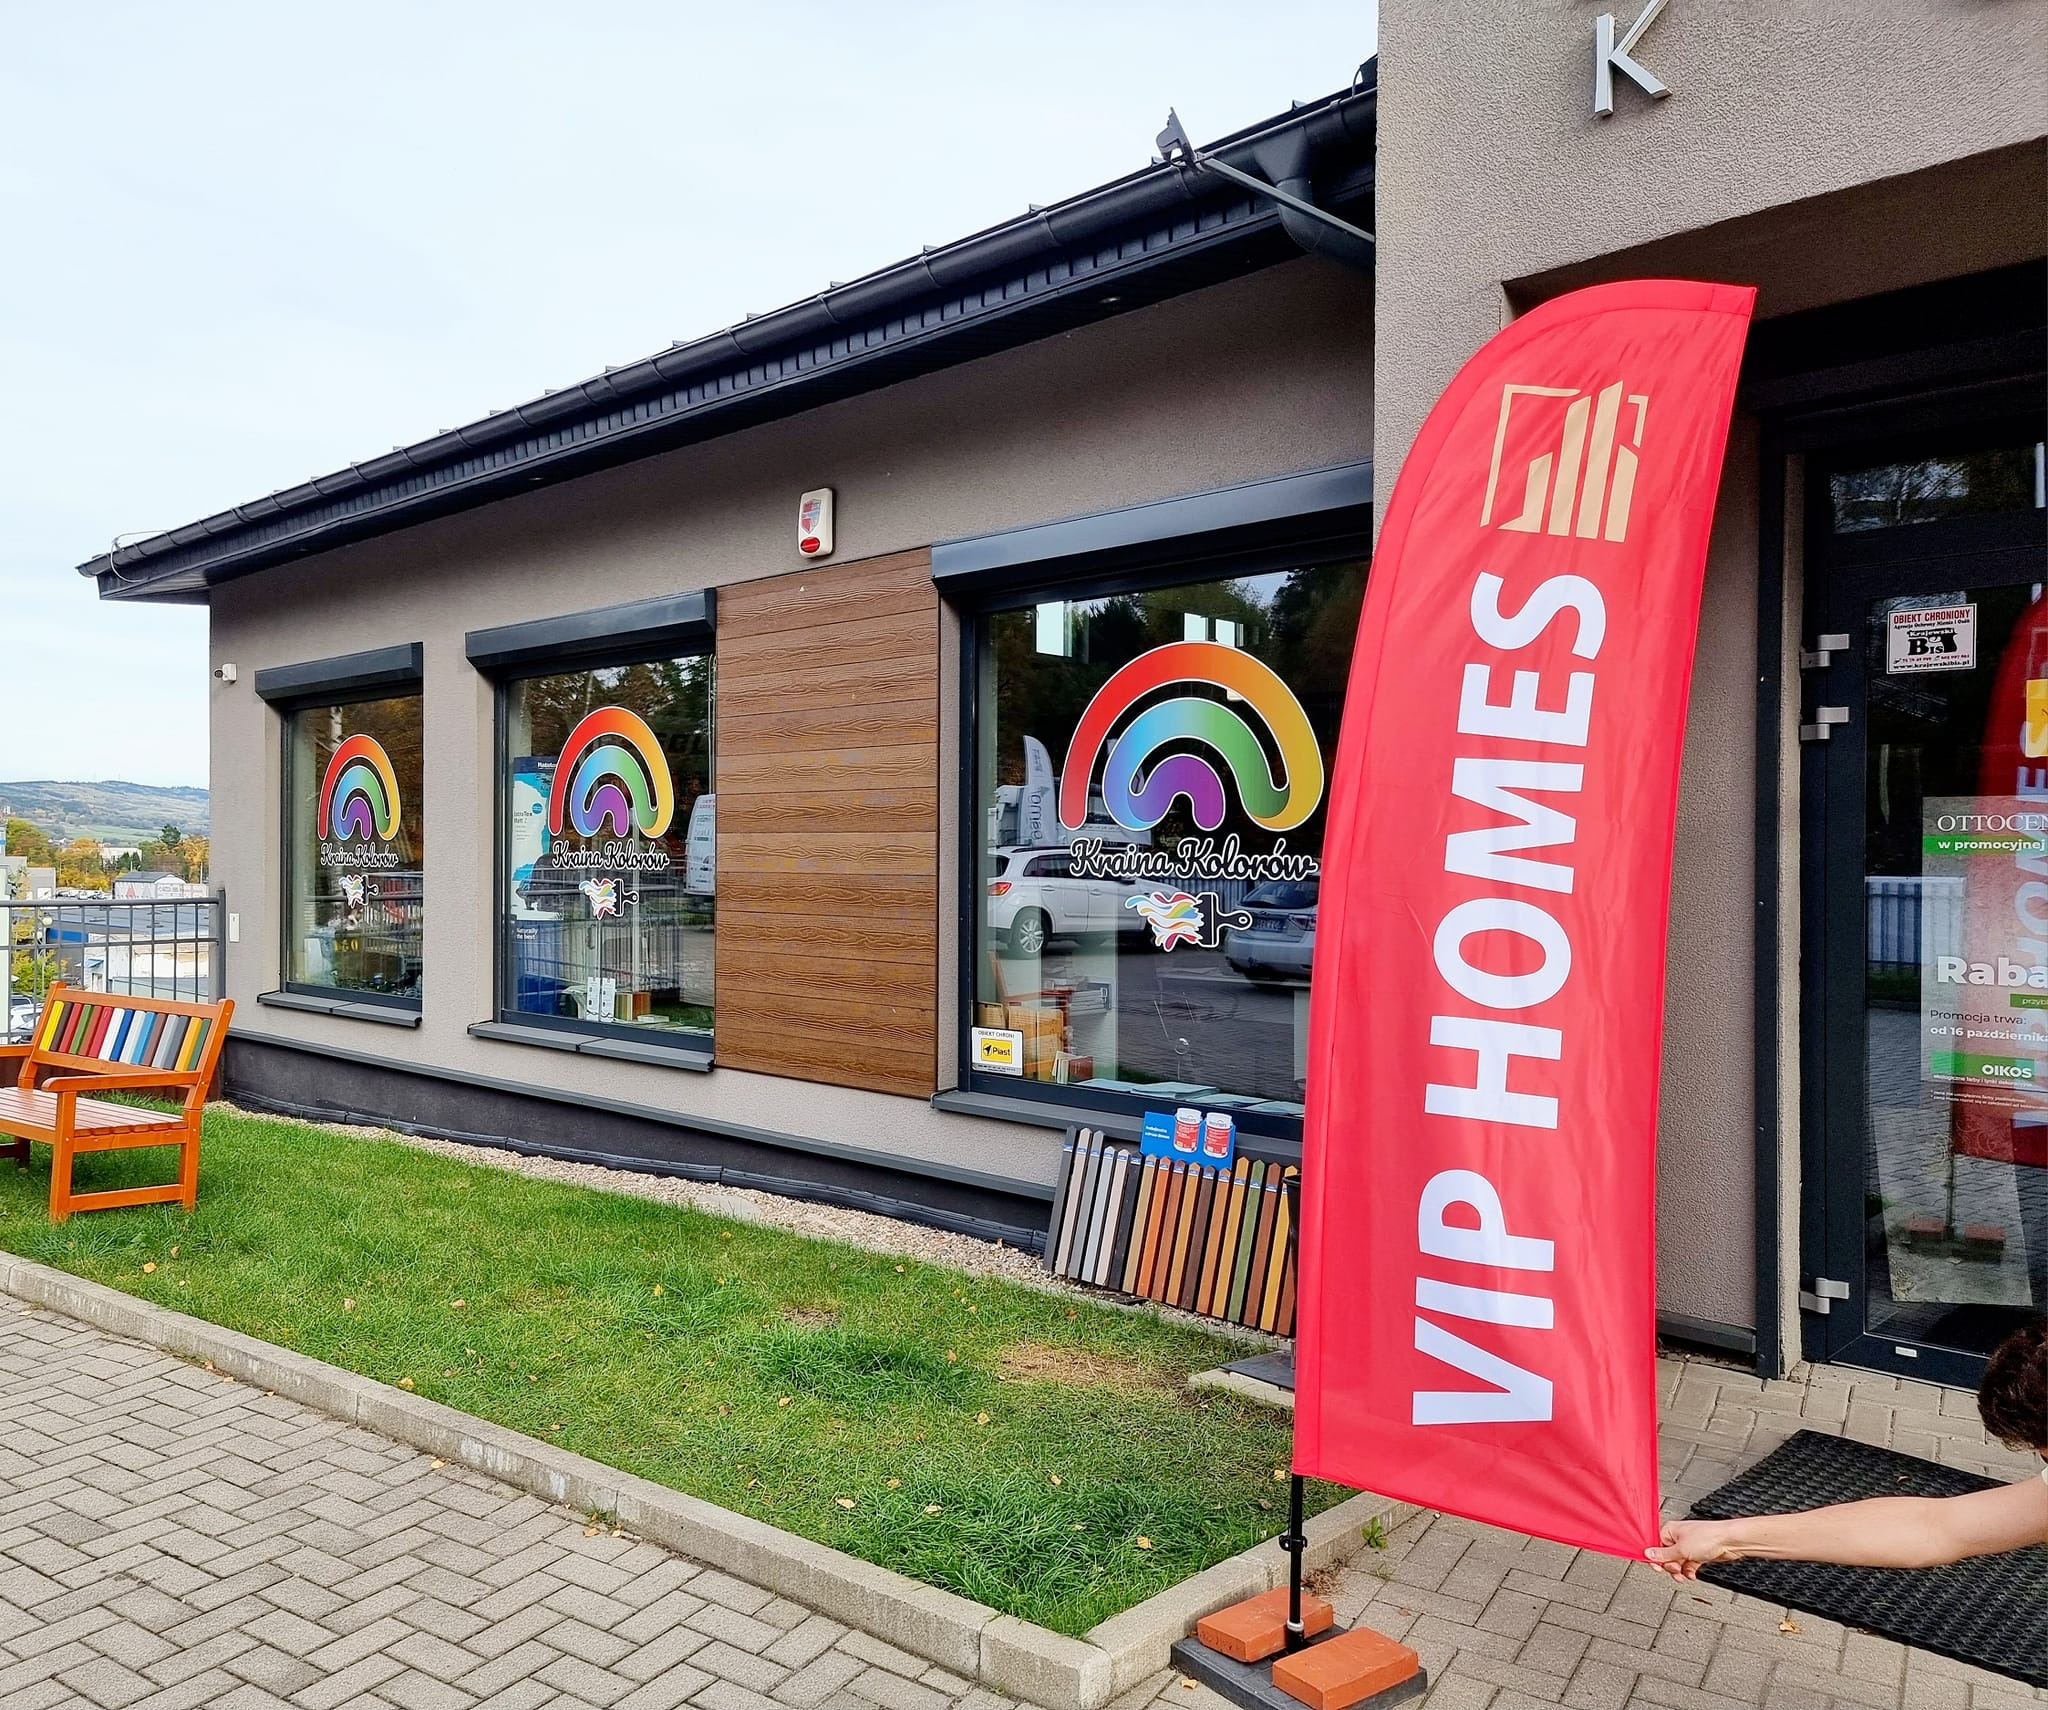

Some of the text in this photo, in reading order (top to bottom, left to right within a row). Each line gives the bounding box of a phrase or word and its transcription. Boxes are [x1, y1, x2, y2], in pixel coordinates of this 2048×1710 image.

[1594, 0, 1672, 117] K
[1894, 609, 1970, 624] OBIEKT CHRONIONY
[1938, 839, 2045, 851] w promocyjnej
[320, 841, 399, 868] Kraina Kolorów
[552, 838, 671, 871] Kraina Kolorów
[1070, 833, 1318, 881] Kraina Kolorów
[1412, 570, 1607, 1426] VIP HOMES
[1930, 1010, 2027, 1025] Promocja trwa:
[1930, 1026, 1947, 1035] od
[1950, 1027, 1964, 1037] 16
[992, 1047, 1010, 1056] Piast
[1981, 1064, 2033, 1079] OIKOS
